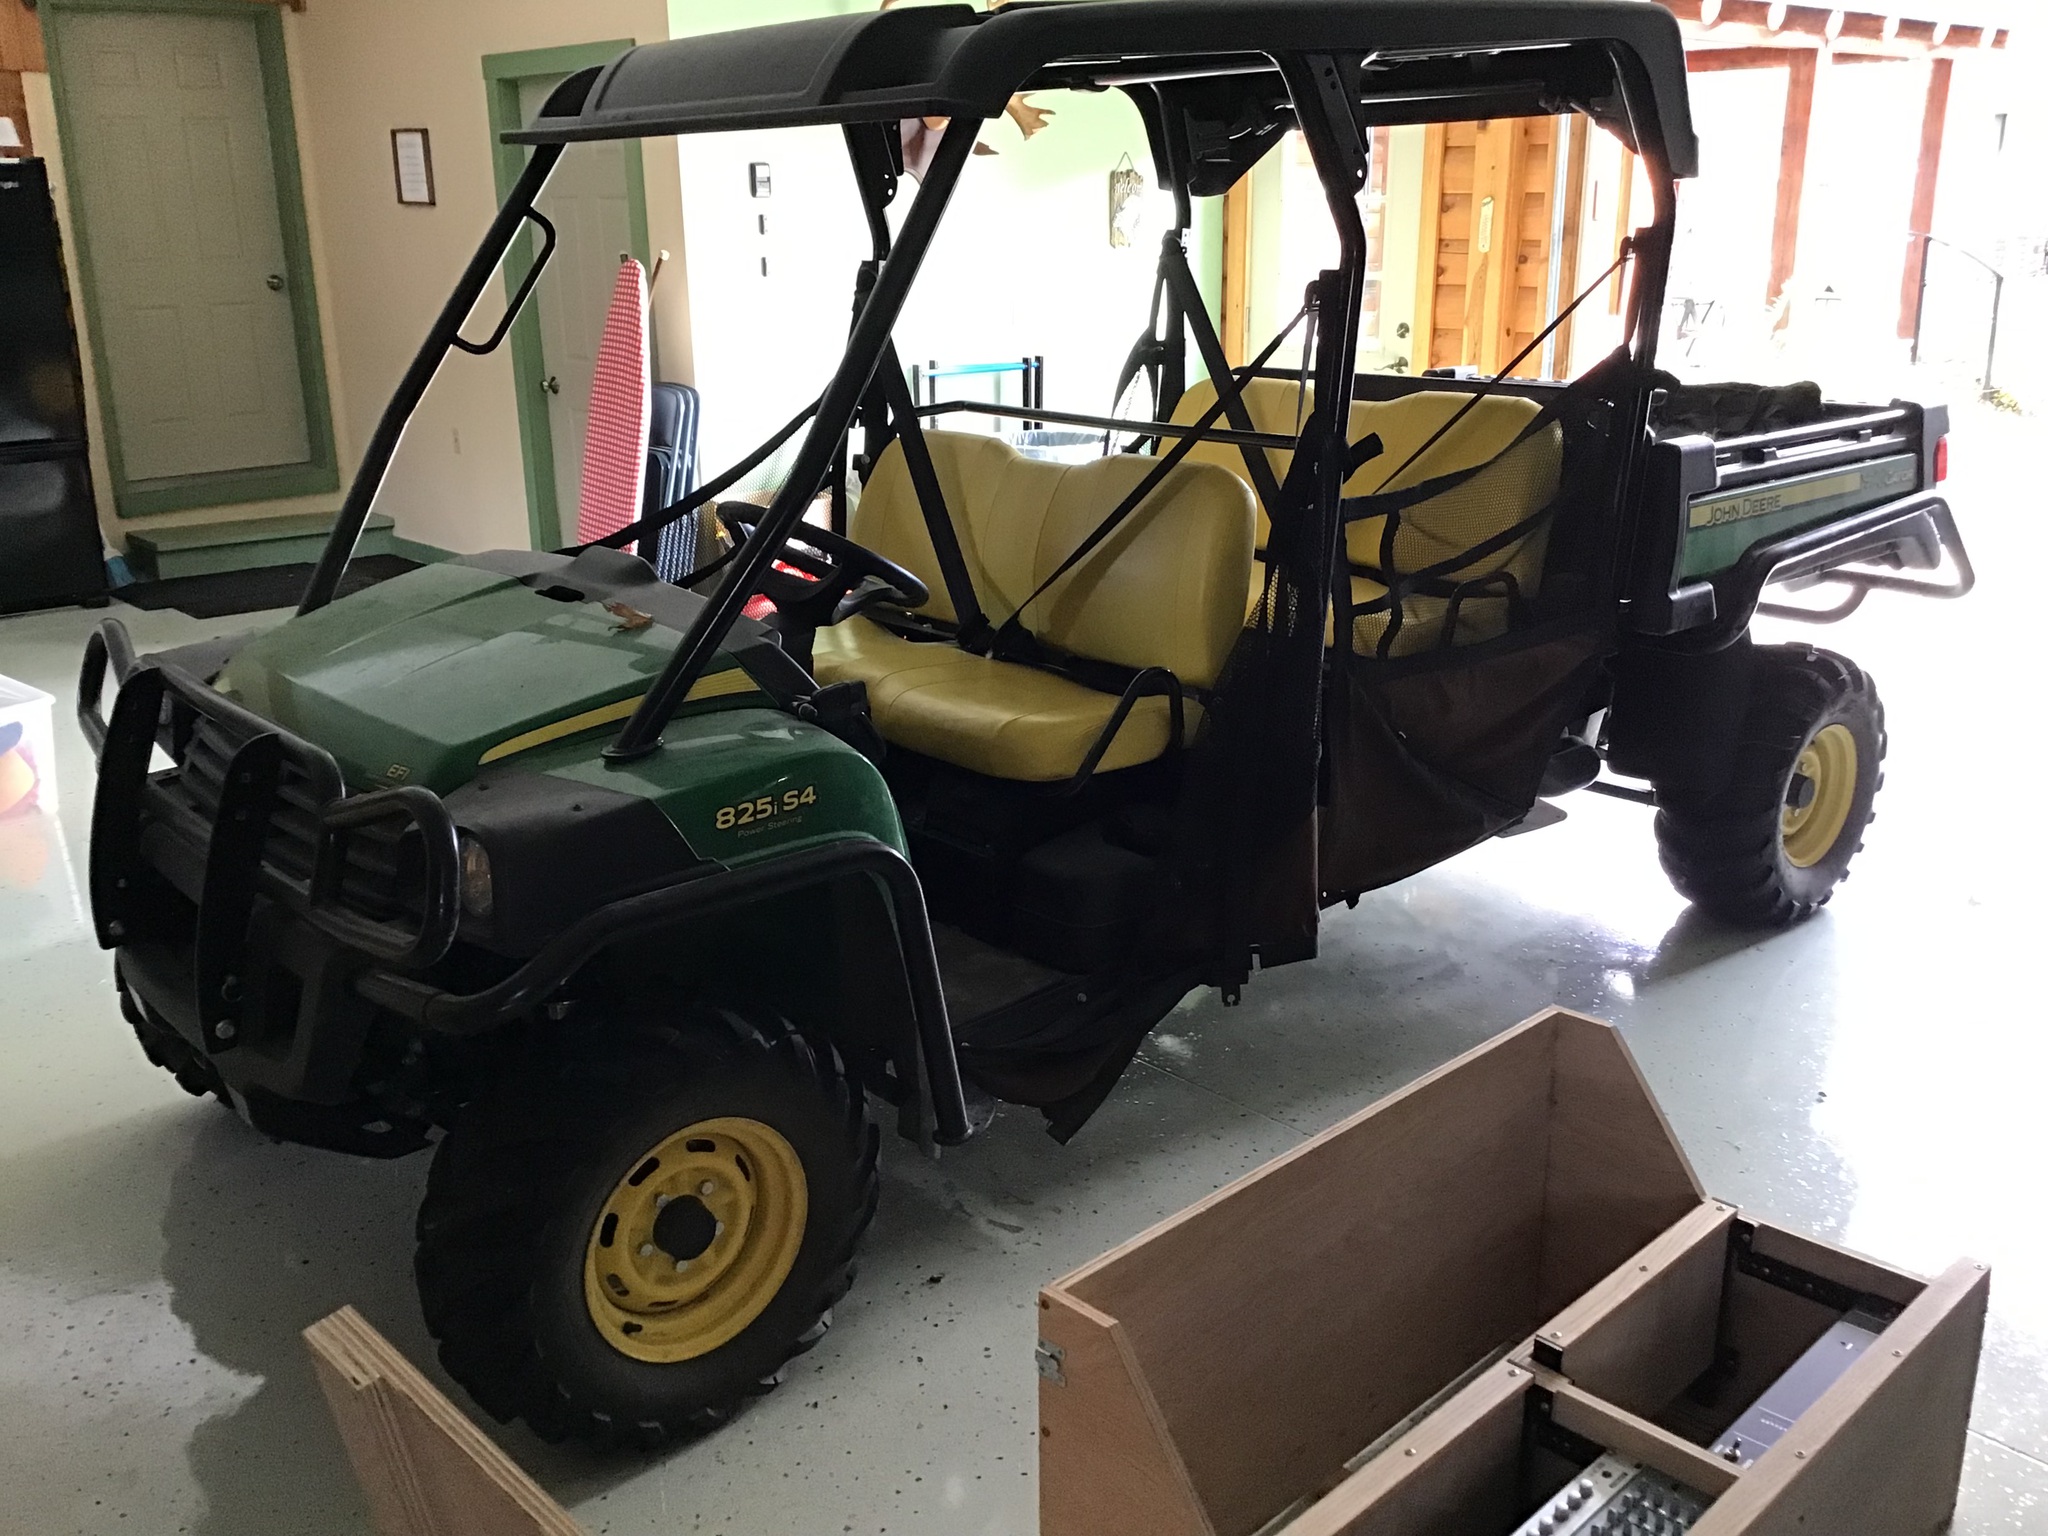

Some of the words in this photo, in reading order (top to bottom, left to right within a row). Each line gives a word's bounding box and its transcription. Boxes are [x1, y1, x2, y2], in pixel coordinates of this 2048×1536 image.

[1706, 503, 1740, 524] JOHN
[1743, 494, 1782, 515] DEERE
[387, 764, 410, 780] EFI
[715, 796, 778, 829] 825i
[783, 785, 817, 811] S4
[737, 825, 765, 838] Power
[767, 815, 803, 831] Steering
